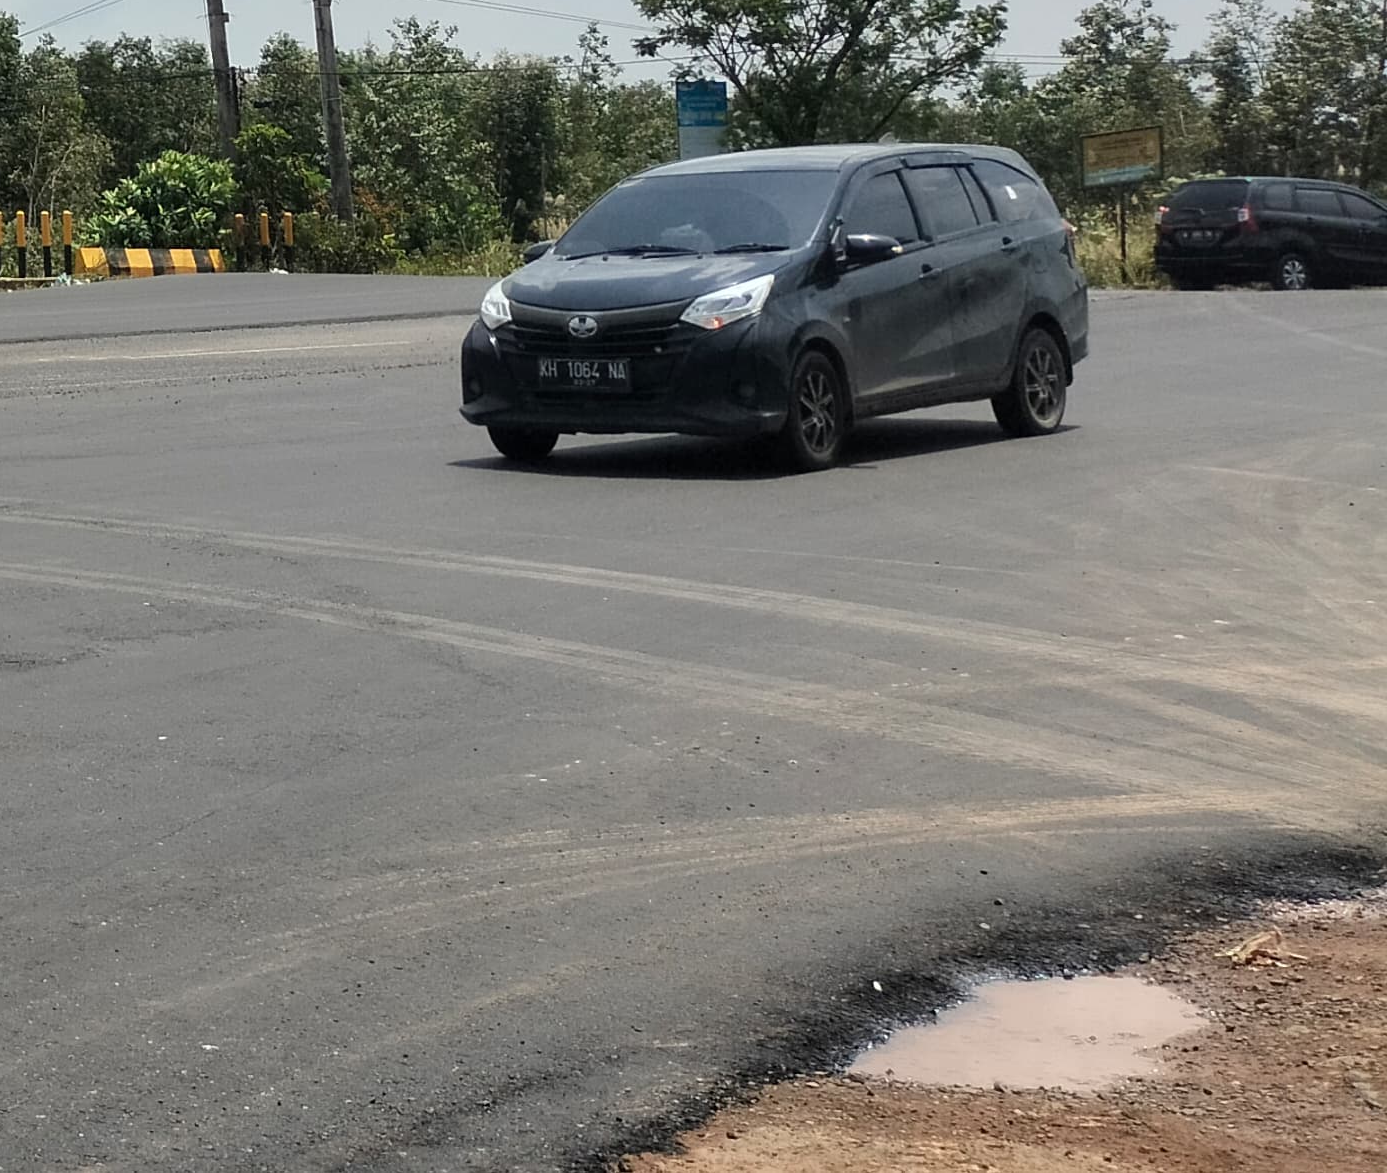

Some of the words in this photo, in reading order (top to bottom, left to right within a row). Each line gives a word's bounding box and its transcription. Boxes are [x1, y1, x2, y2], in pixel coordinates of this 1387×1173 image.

[539, 359, 558, 378] KH
[568, 361, 600, 378] 1064
[608, 362, 626, 379] NA
